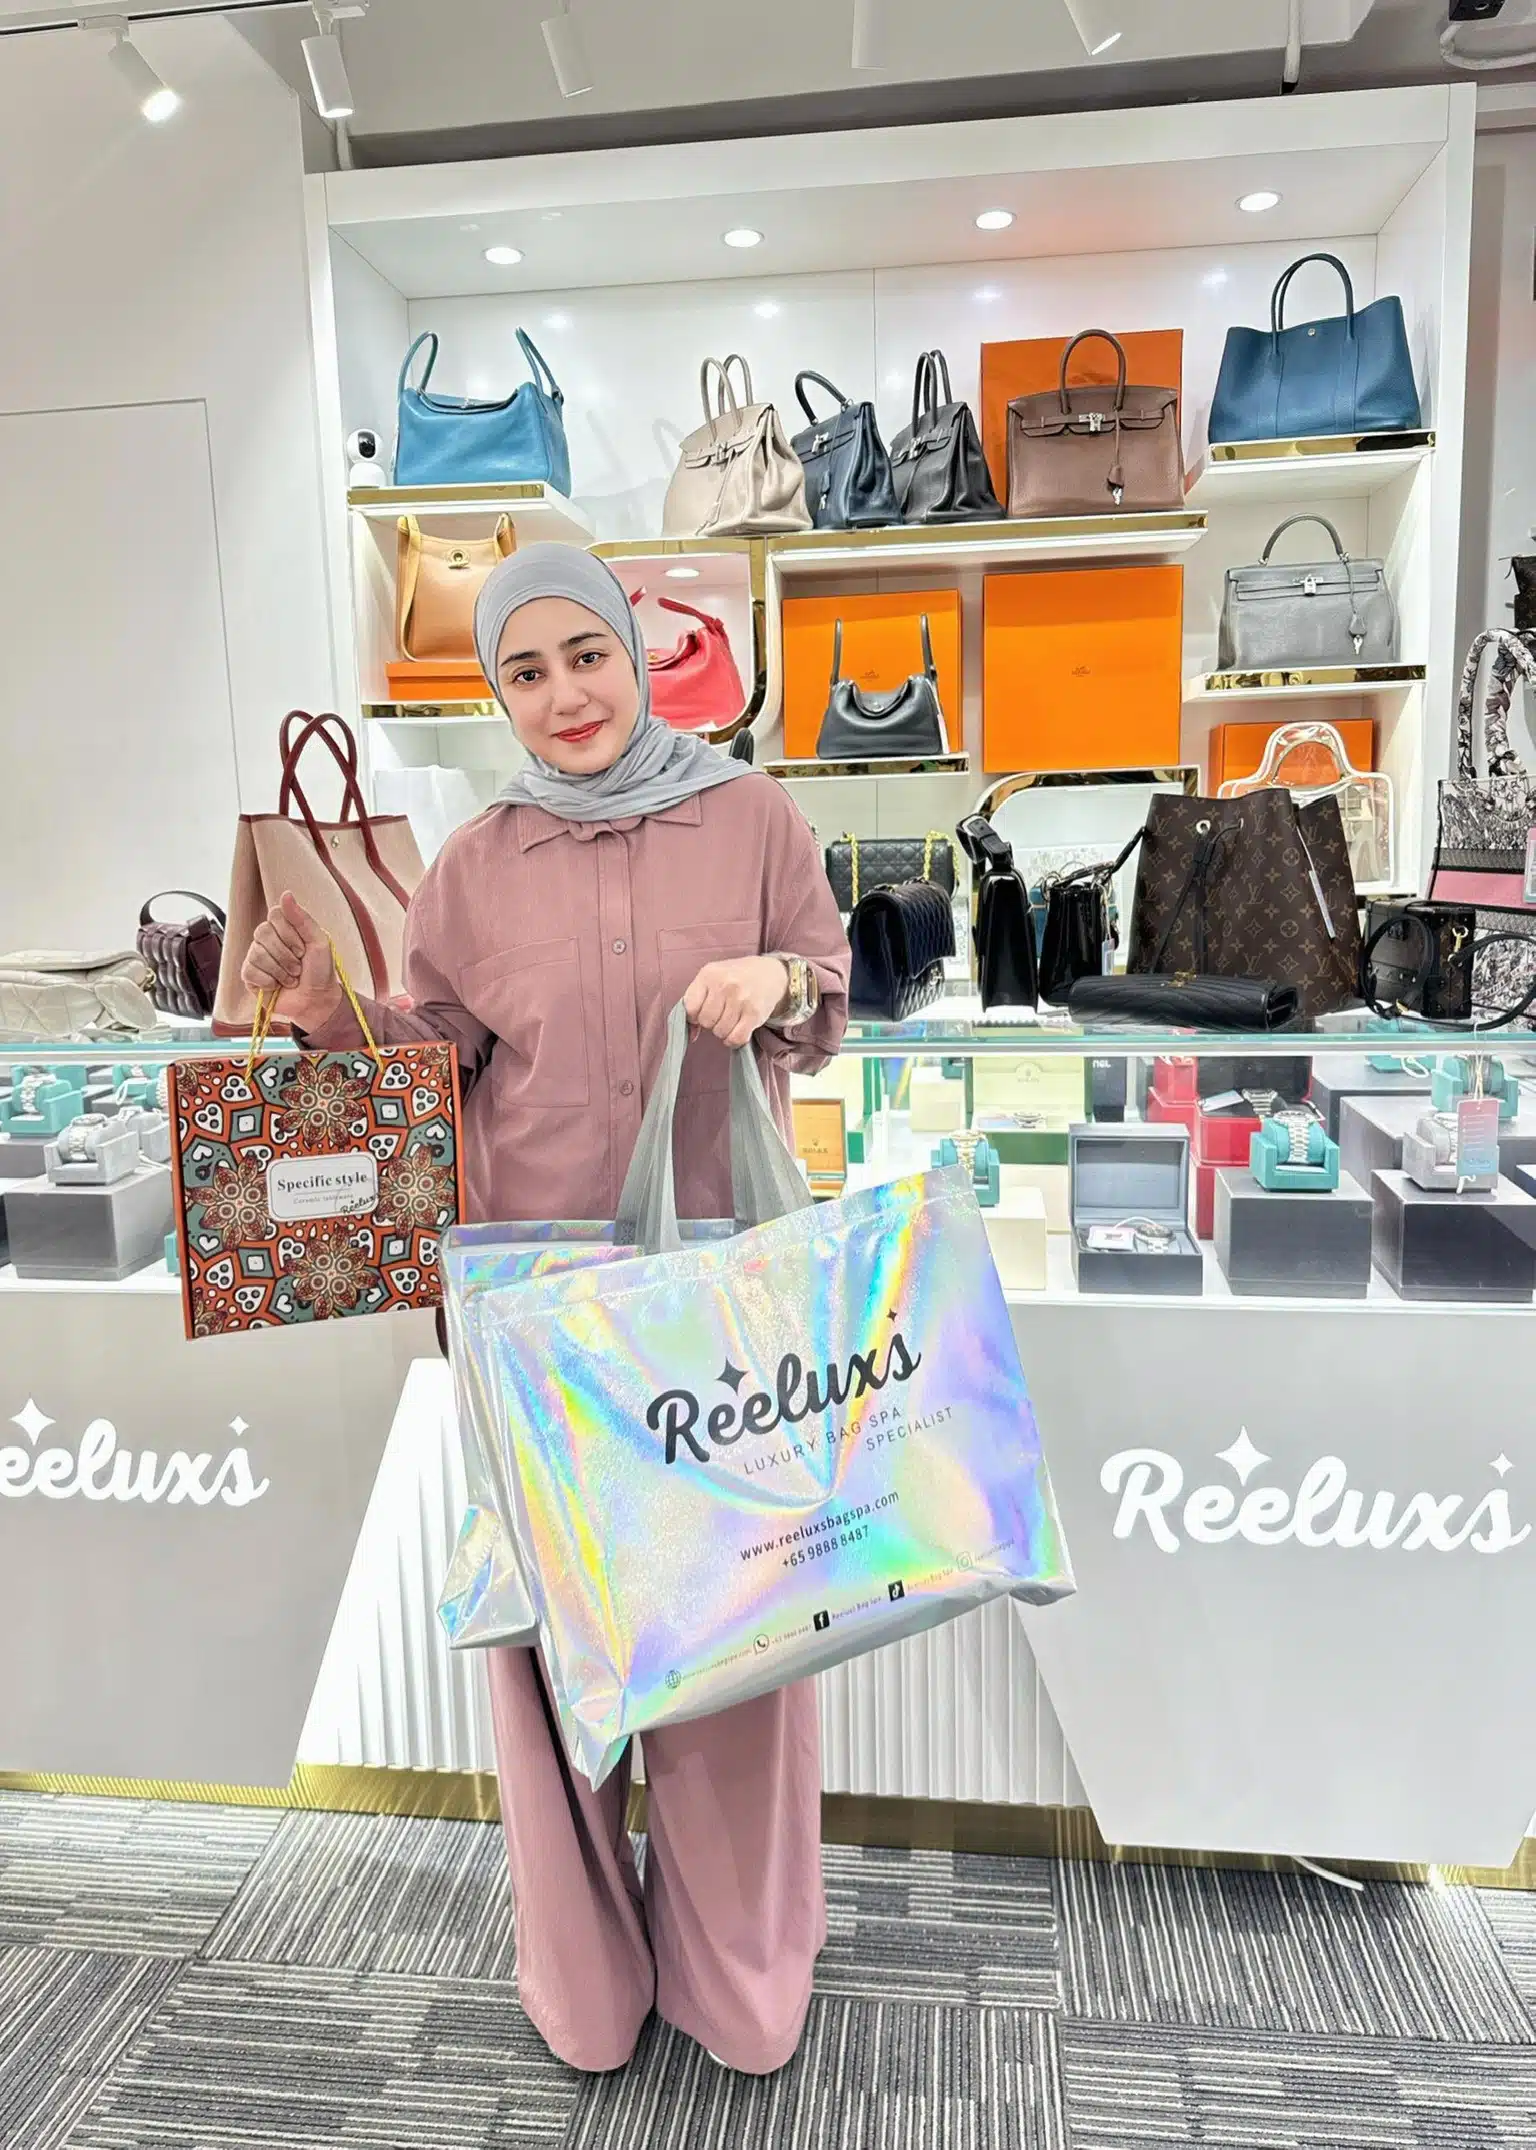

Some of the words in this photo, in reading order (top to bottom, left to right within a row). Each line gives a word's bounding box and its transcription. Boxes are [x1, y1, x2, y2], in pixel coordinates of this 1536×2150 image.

[277, 1174, 332, 1192] Specific
[335, 1171, 368, 1187] style
[646, 1333, 922, 1464] Reeluxs
[866, 1406, 953, 1452] SPECIALIST
[743, 1438, 818, 1475] LUXURY
[826, 1420, 862, 1444] BAG
[869, 1408, 902, 1429] SPA
[740, 1490, 900, 1562] www.reeluxsbagspa.com
[1099, 1448, 1533, 1554] Reeluxs
[782, 1551, 806, 1568] +65
[807, 1538, 839, 1561] 9888
[840, 1524, 869, 1547] 8487
